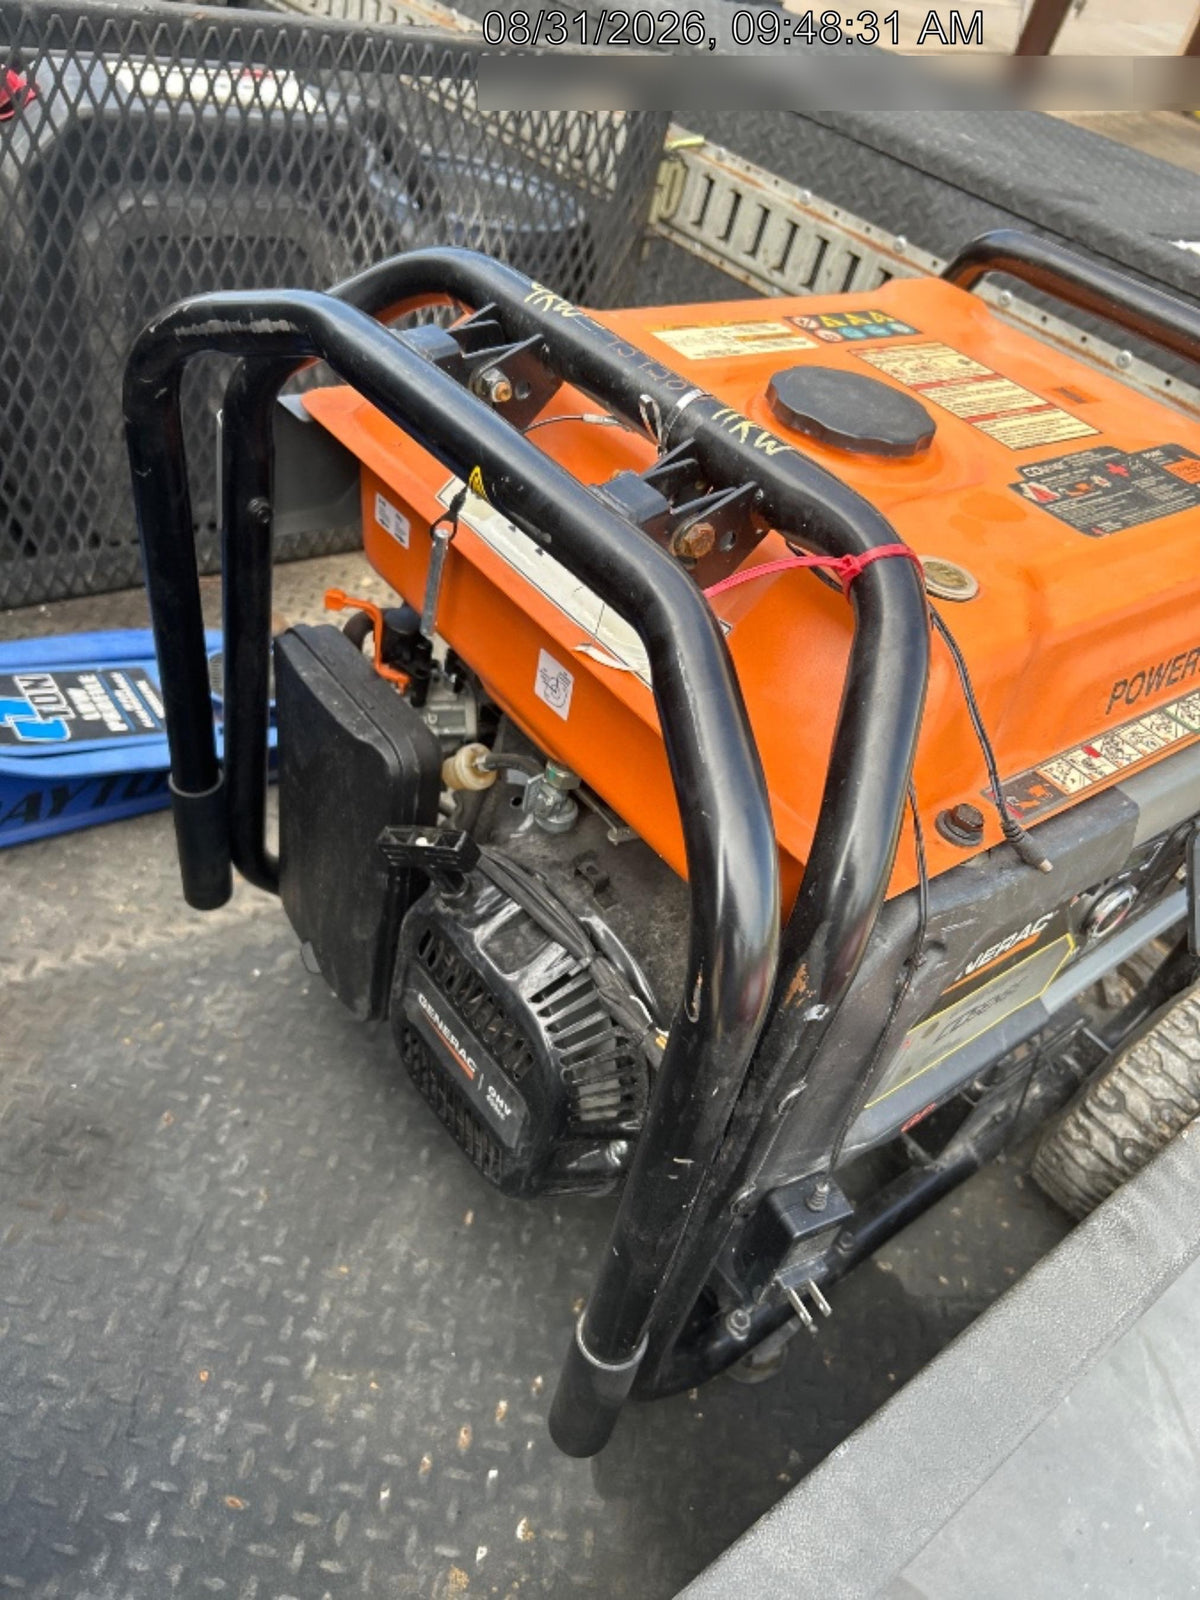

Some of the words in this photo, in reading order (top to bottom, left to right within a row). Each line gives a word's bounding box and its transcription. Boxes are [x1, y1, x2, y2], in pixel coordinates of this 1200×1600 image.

[1104, 646, 1200, 716] POWER
[954, 911, 1055, 981] NERAC
[417, 992, 478, 1073] GENERAC
